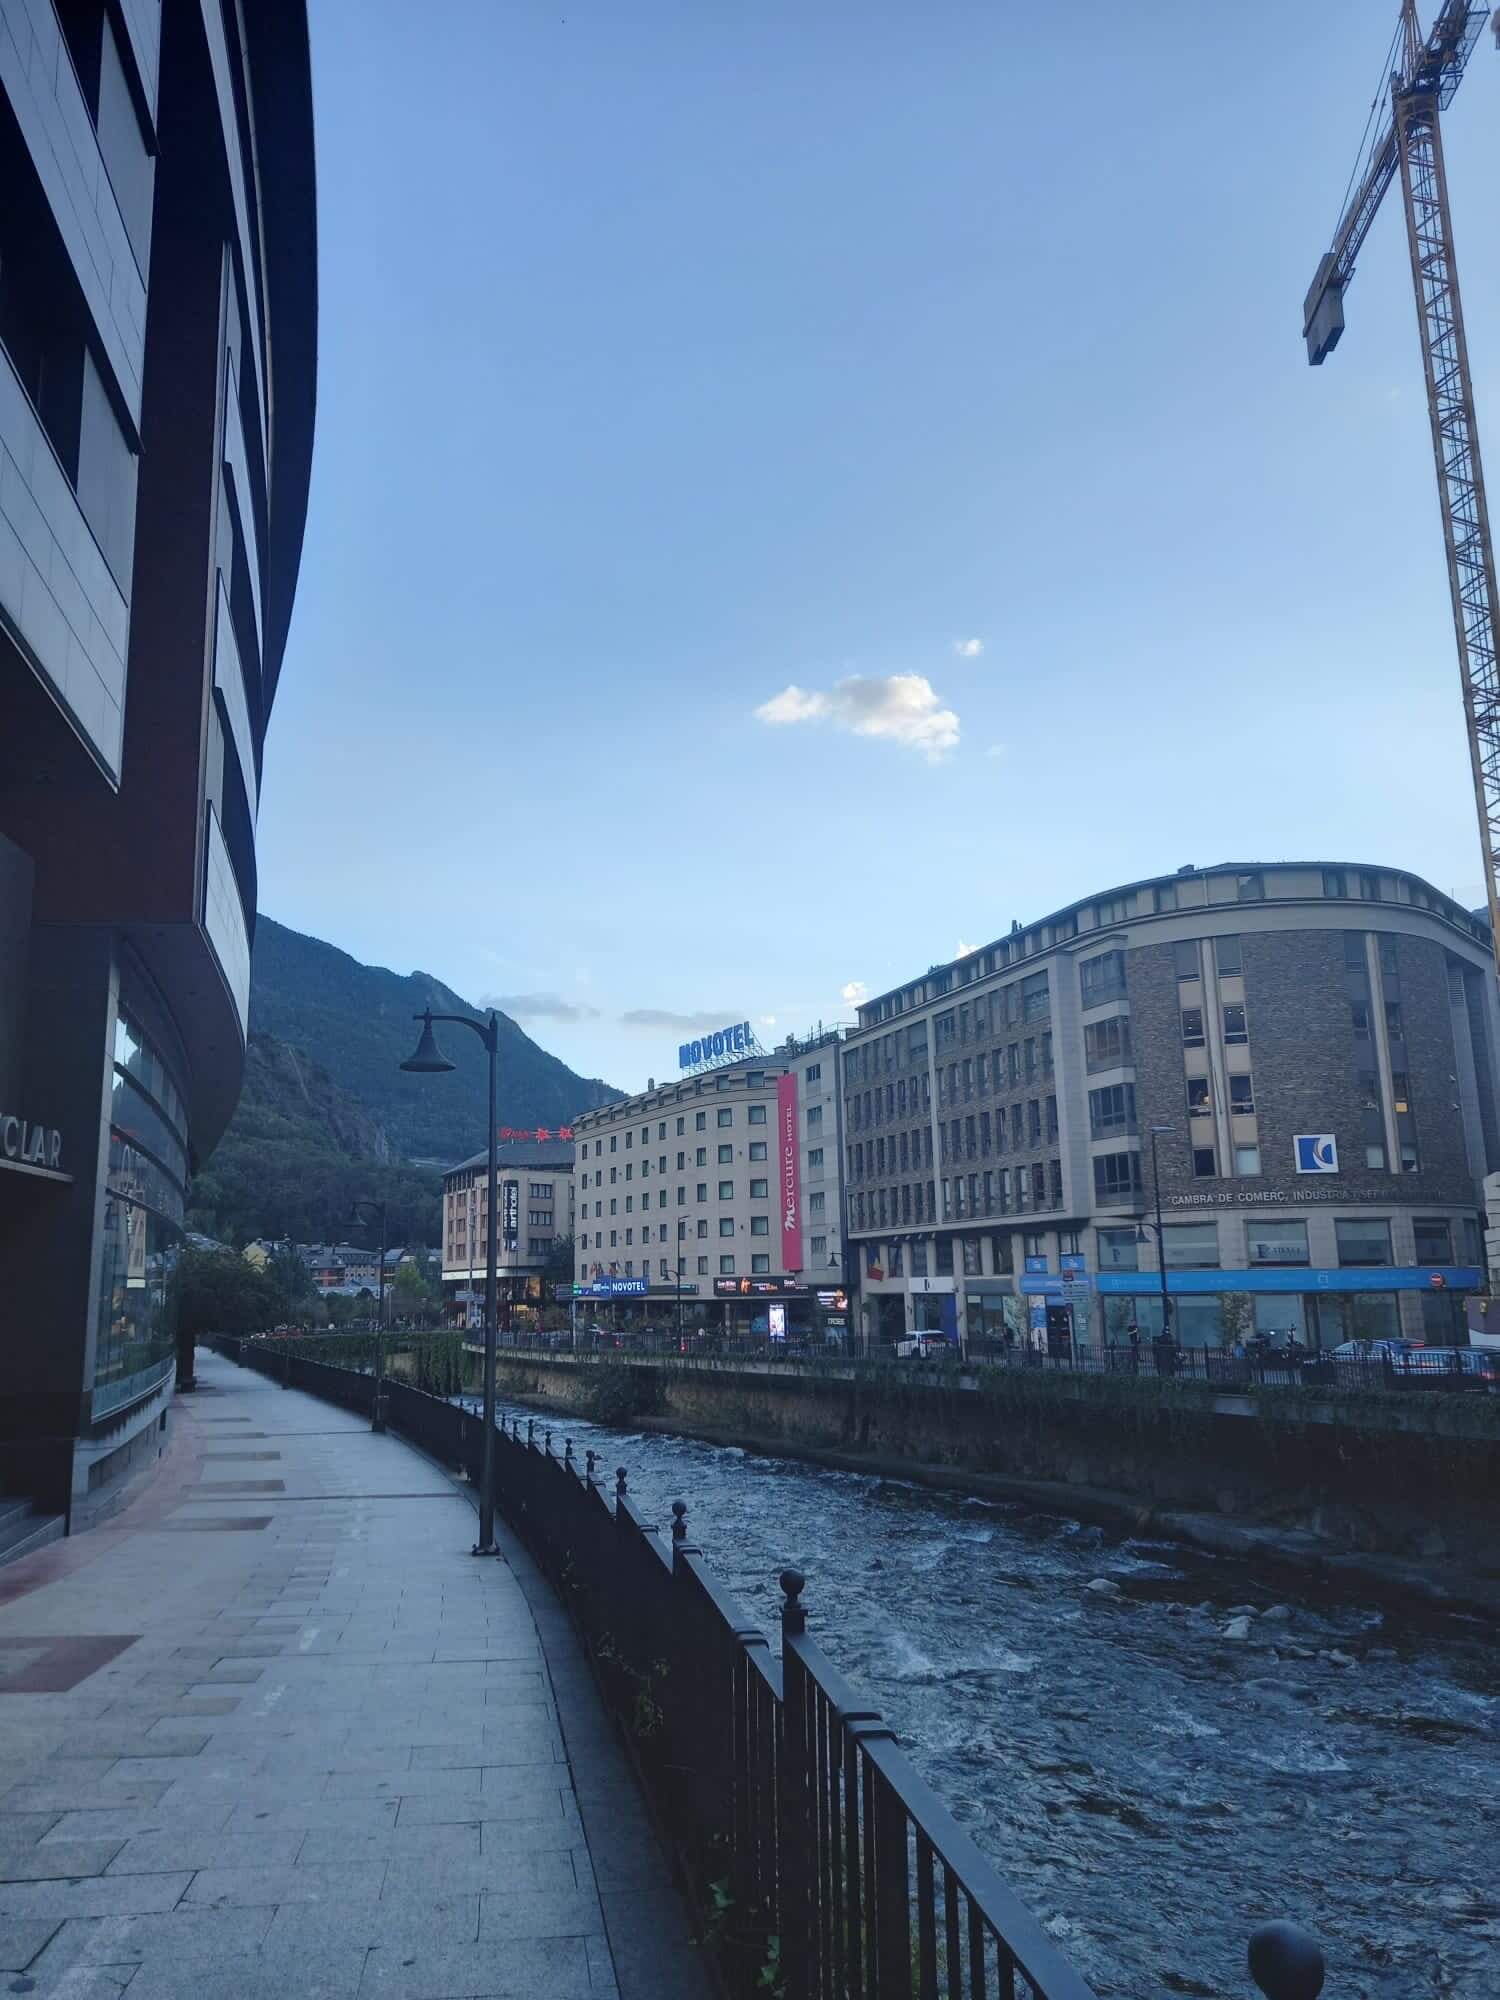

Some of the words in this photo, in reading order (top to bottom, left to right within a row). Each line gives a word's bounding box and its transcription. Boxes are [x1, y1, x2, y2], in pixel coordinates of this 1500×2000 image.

[679, 1020, 754, 1068] NOVOTEL
[0, 1112, 61, 1168] CLAR
[784, 1146, 796, 1232] Mercure
[1171, 1193, 1214, 1205] CAMBRA
[1218, 1192, 1233, 1203] DE
[612, 1280, 645, 1292] NOVOTEL
